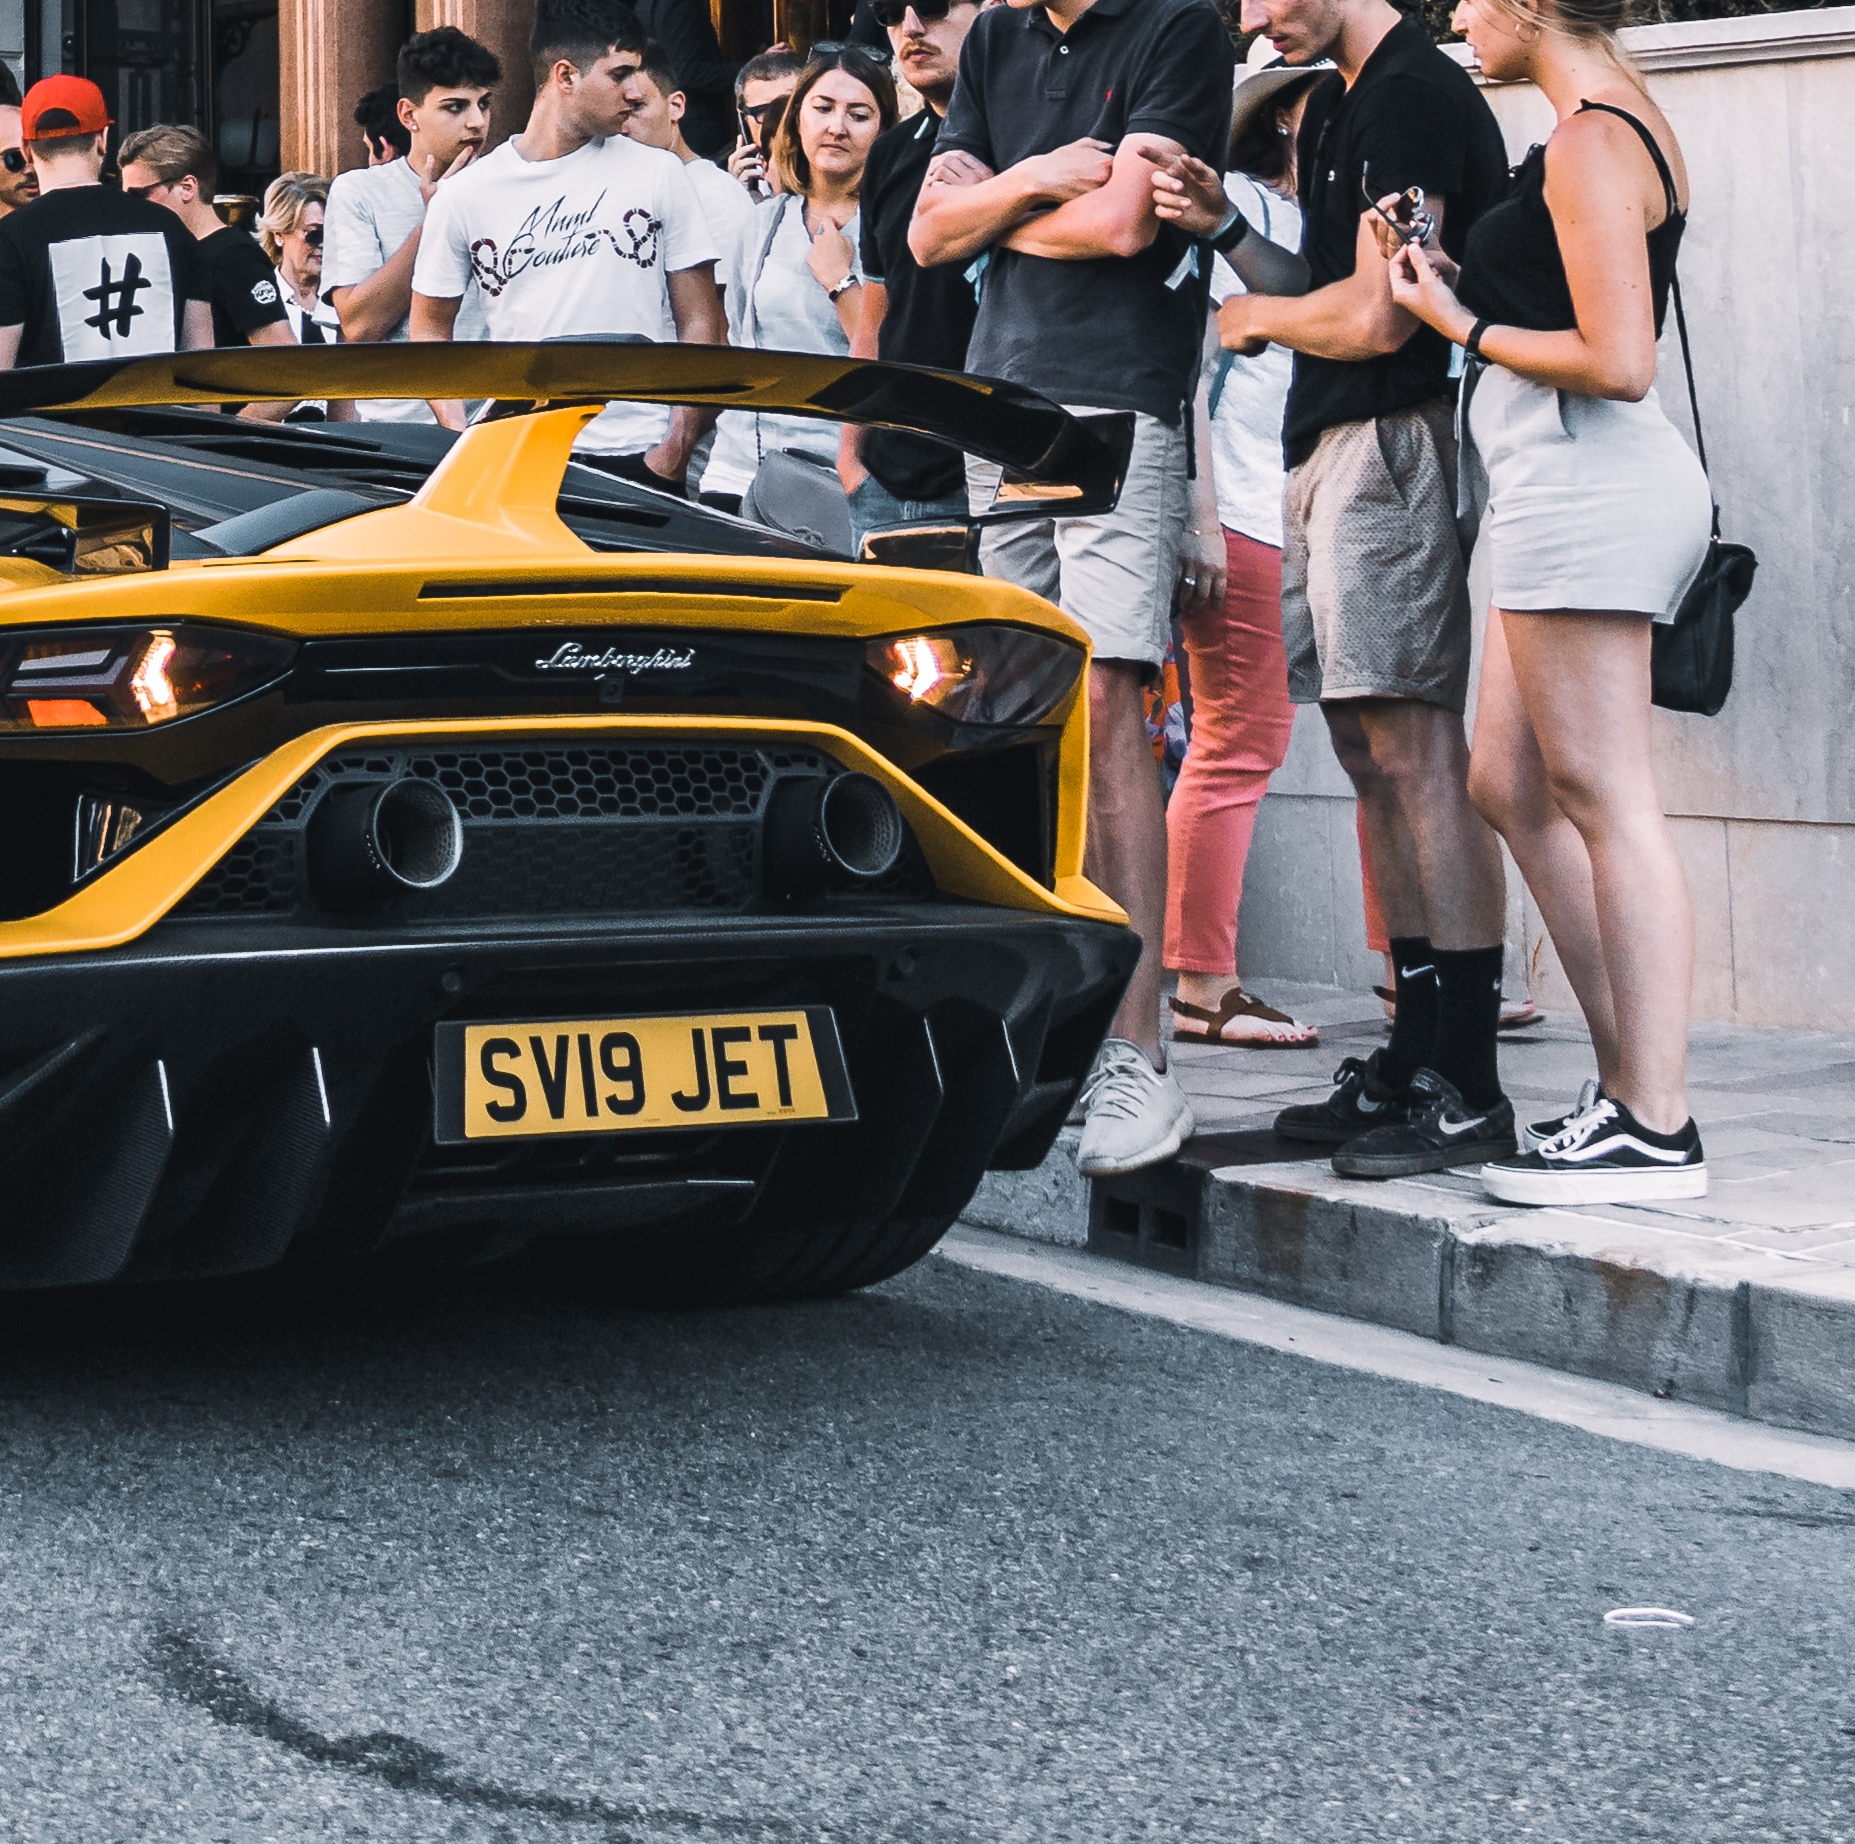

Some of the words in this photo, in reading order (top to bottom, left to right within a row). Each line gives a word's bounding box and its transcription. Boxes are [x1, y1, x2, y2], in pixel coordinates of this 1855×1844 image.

[535, 642, 696, 674] Lamborghini
[480, 1032, 645, 1122] SV19
[671, 1024, 798, 1112] JET
